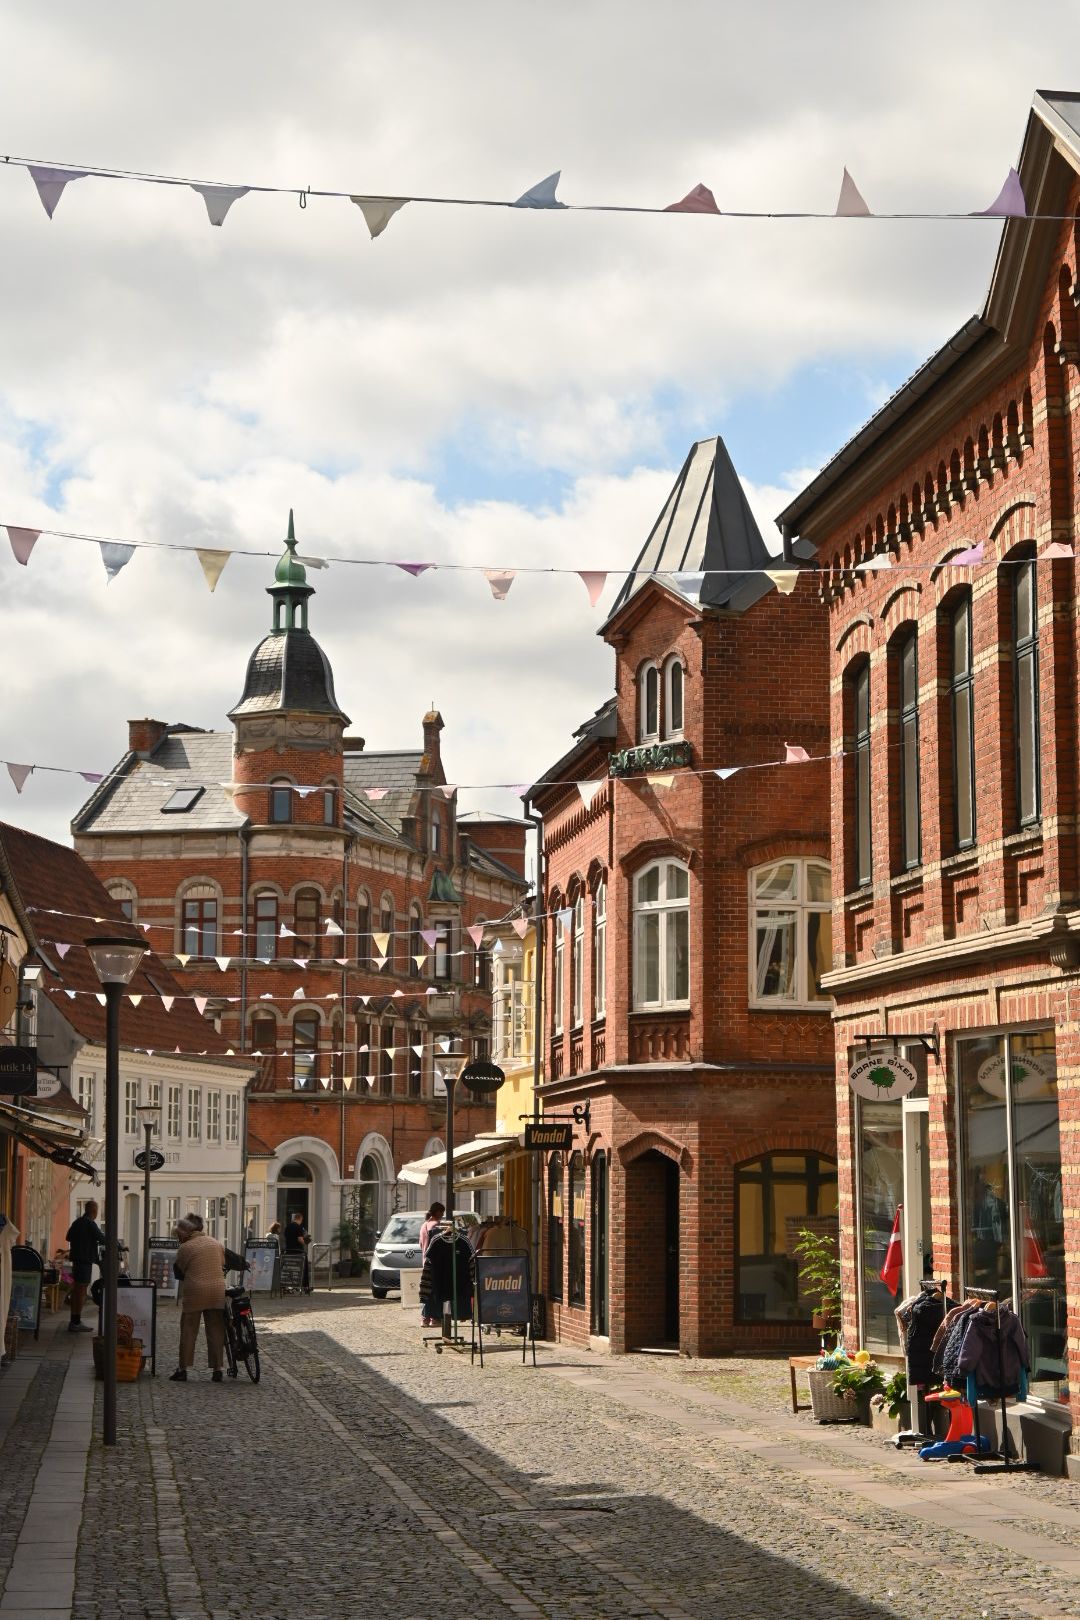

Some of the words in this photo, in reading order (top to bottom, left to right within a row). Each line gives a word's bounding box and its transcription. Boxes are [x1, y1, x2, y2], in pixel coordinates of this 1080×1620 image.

[0, 1062, 19, 1072] utik
[21, 1063, 33, 1073] 14
[531, 1129, 567, 1144] Vandal
[484, 1275, 523, 1291] Vandal
